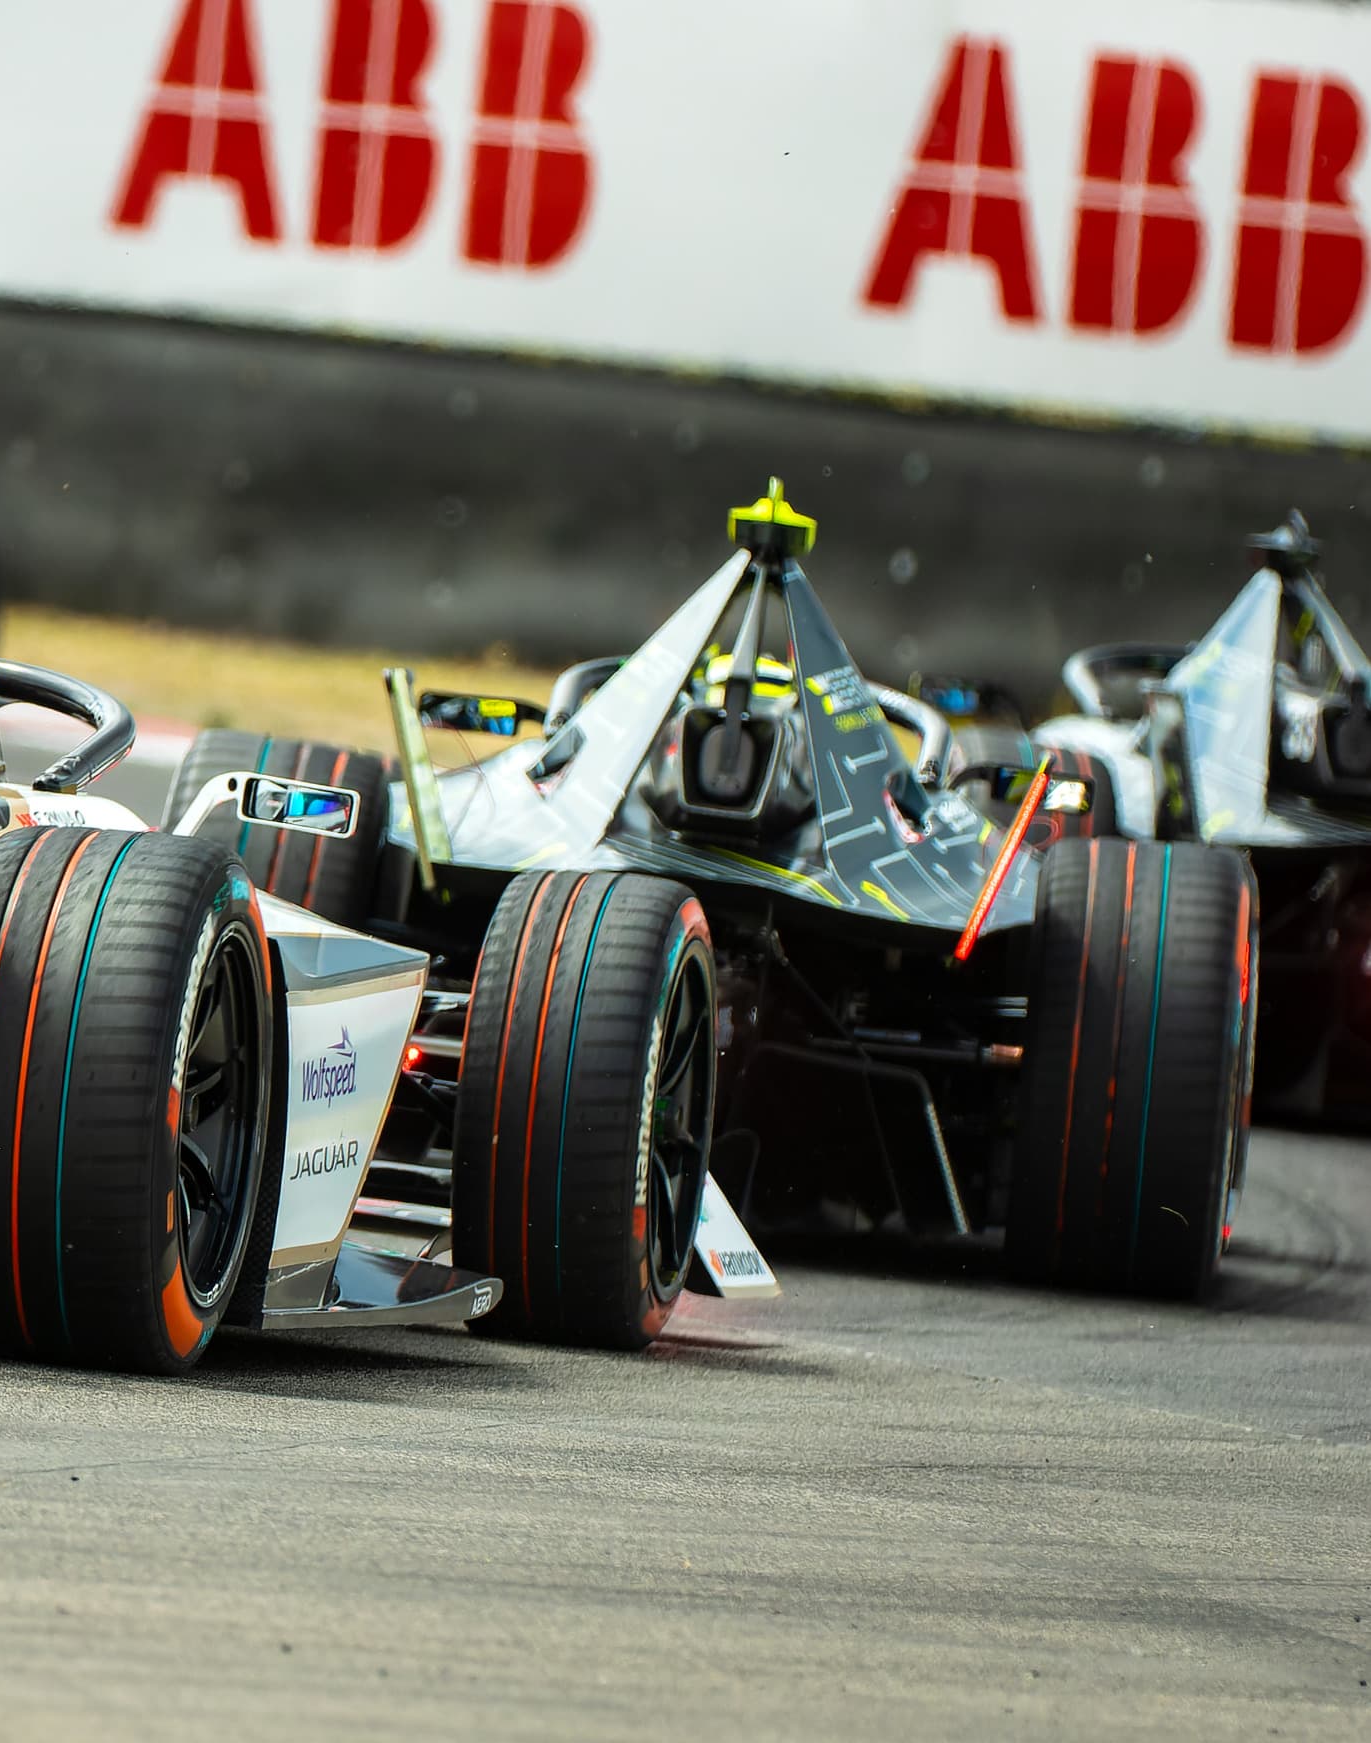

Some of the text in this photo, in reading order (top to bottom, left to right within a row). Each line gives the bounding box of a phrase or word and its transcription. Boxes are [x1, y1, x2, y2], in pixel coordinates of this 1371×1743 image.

[110, 0, 596, 271] ABB
[860, 36, 1370, 355] ABB
[290, 1140, 359, 1181] JAGUAR
